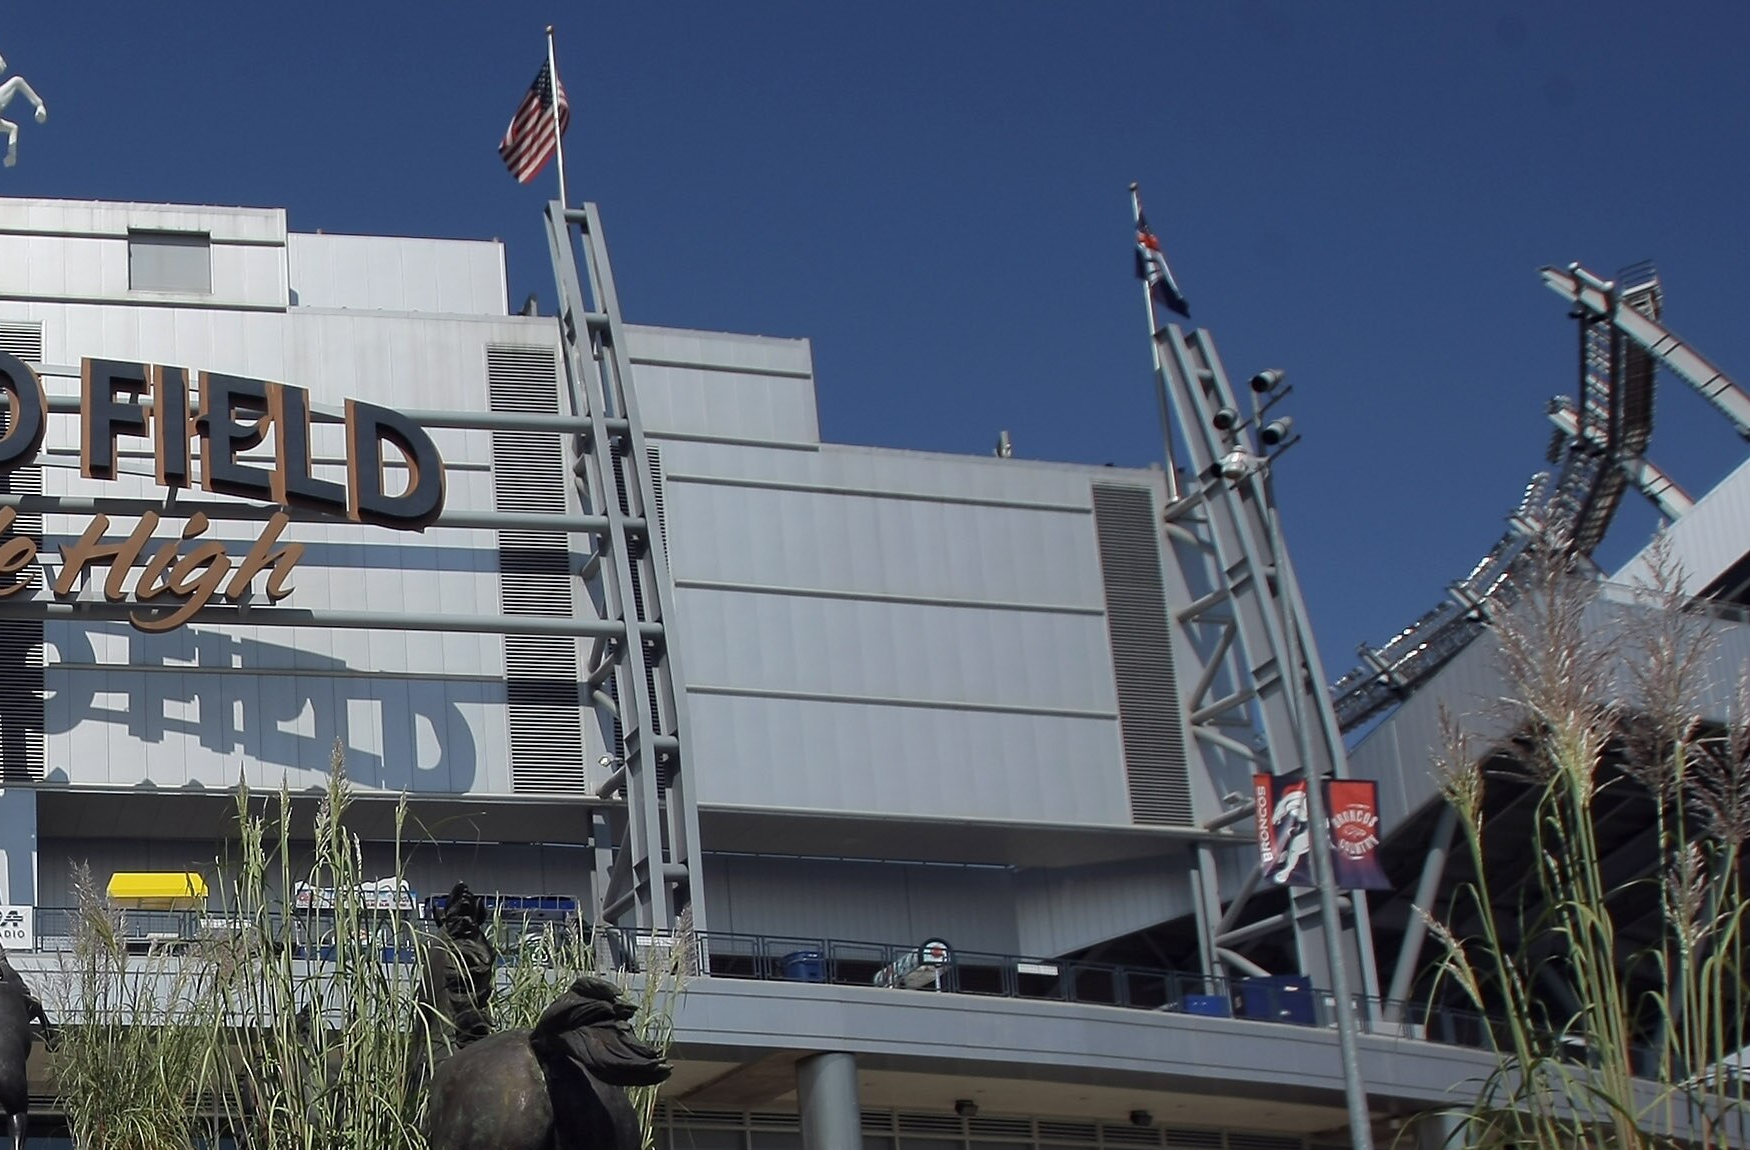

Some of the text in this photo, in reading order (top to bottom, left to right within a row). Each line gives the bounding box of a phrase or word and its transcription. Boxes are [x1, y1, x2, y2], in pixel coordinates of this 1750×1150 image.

[79, 355, 446, 532] FIELD
[50, 510, 307, 633] High
[1257, 785, 1274, 863] BRONCOS
[1331, 809, 1379, 829] BRONCOS
